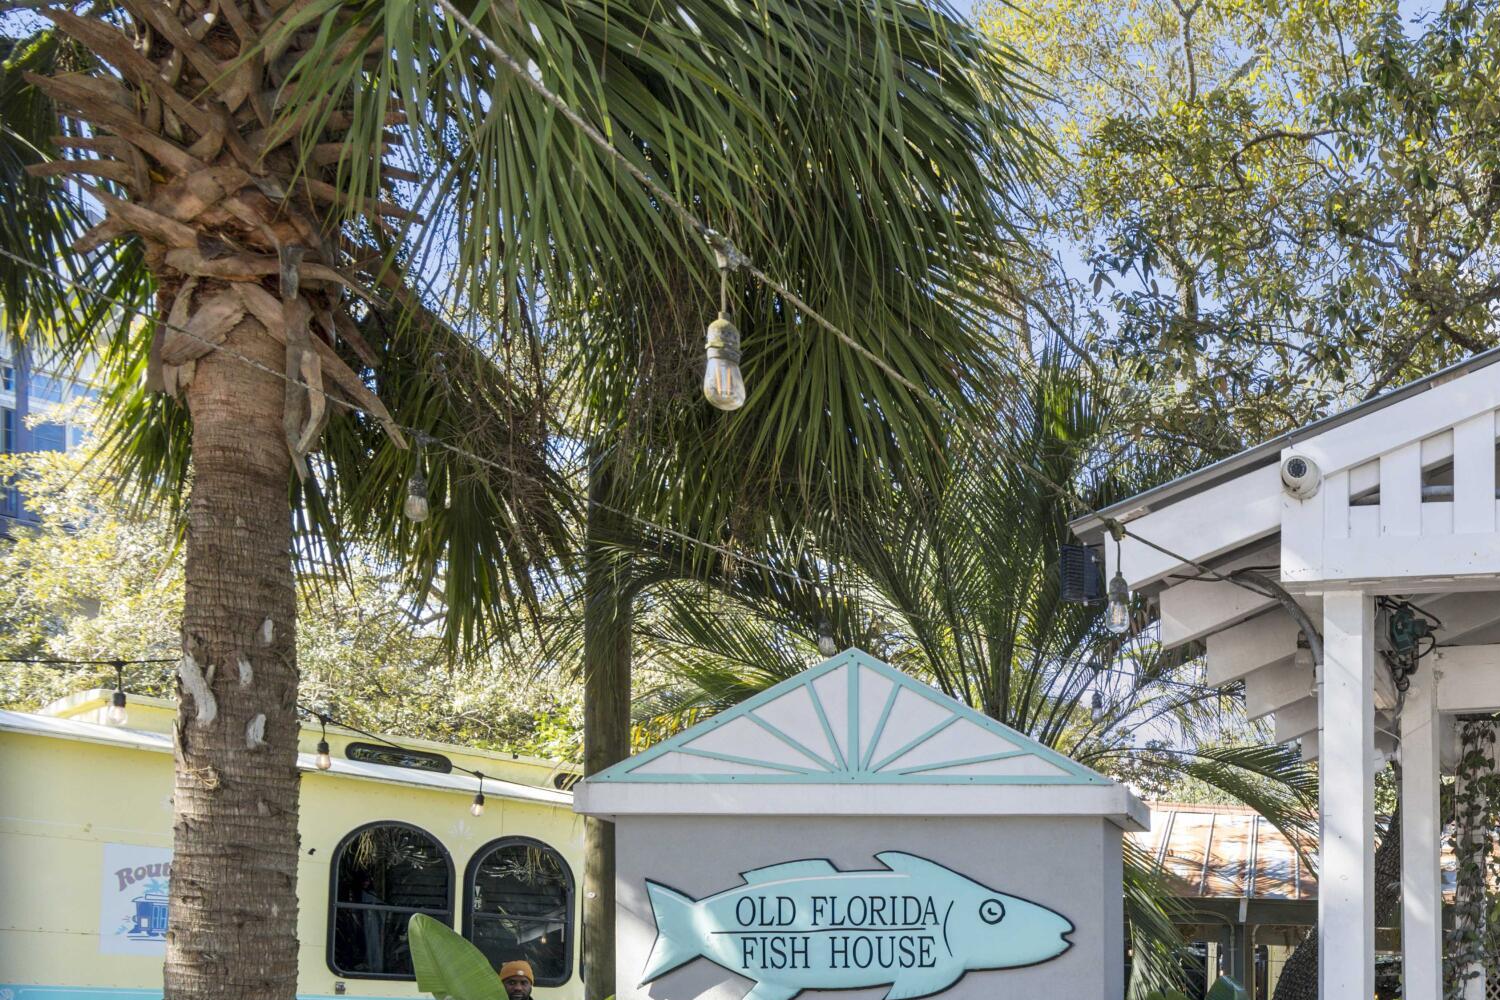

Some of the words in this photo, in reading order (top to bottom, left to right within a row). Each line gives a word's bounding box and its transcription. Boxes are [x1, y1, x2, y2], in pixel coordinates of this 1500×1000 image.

[735, 895, 796, 927] OLD
[811, 895, 939, 927] FLORIDA
[740, 936, 811, 970] FISH
[828, 936, 937, 969] HOUSE
